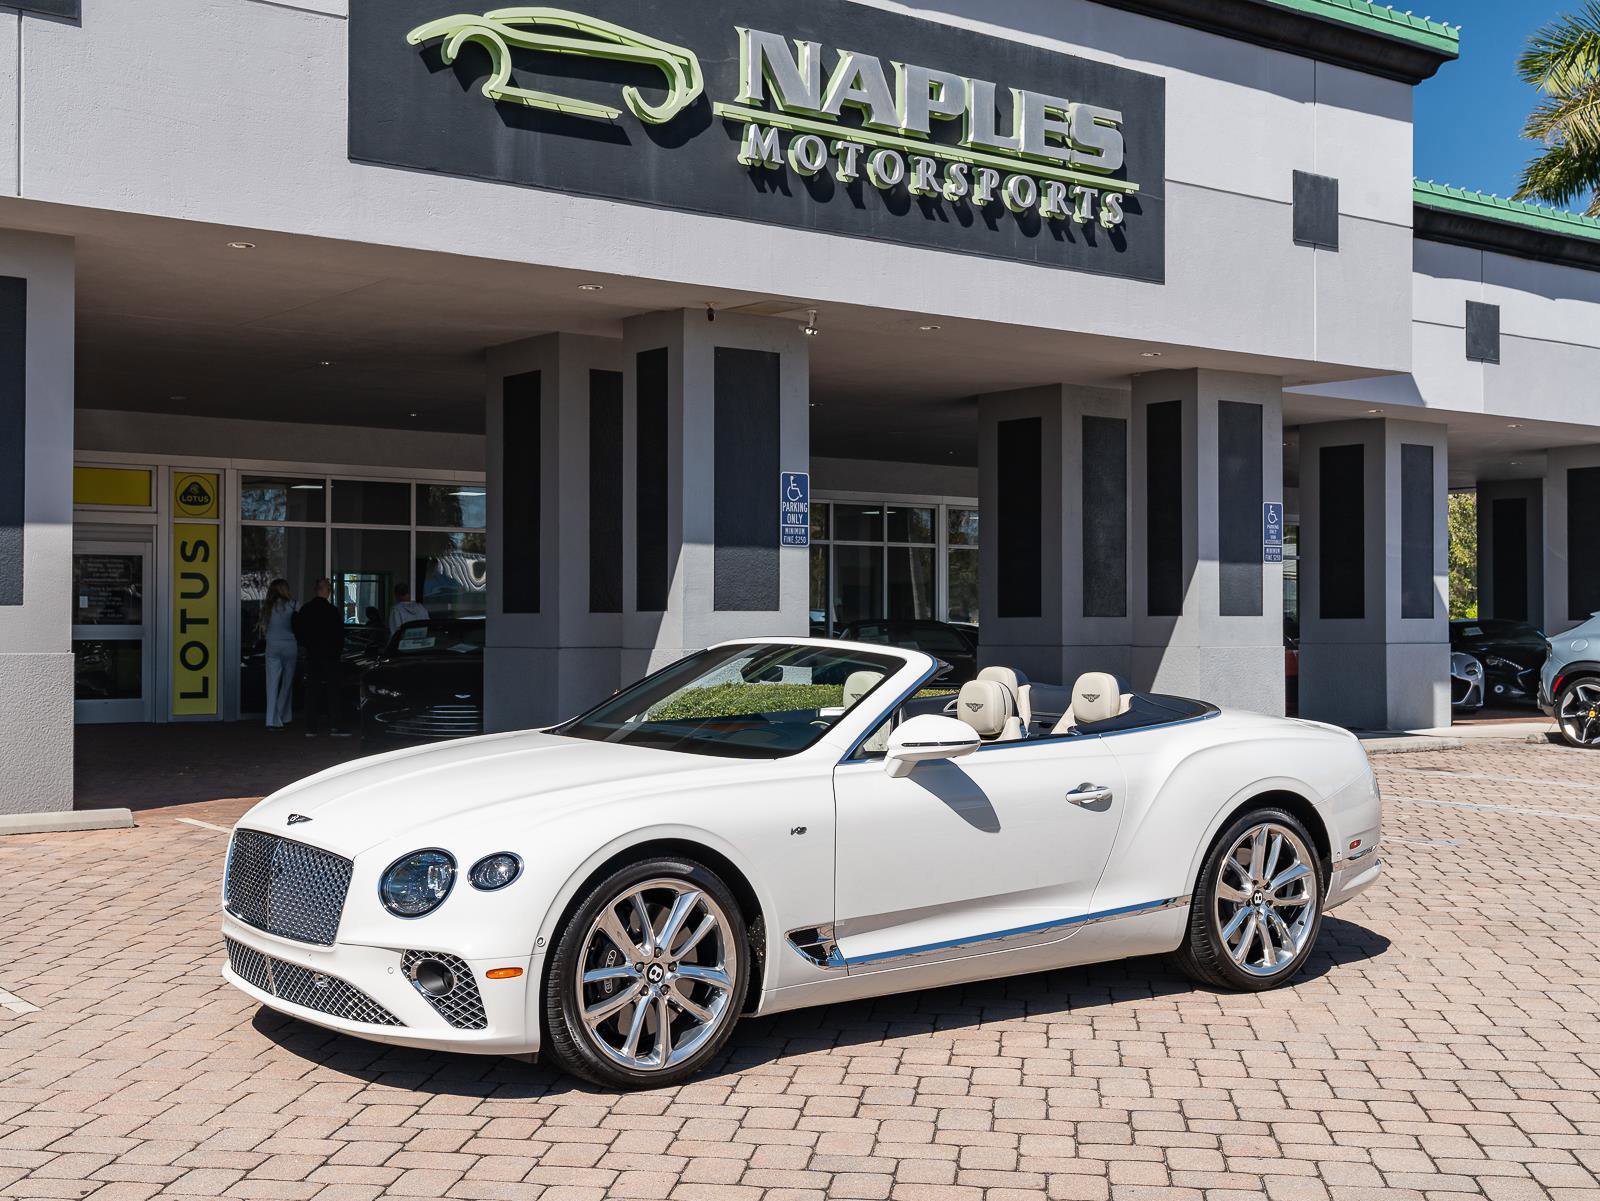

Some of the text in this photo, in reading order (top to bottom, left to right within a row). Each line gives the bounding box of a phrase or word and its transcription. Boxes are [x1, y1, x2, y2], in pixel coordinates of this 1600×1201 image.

[734, 26, 1125, 175] NAPLES
[737, 123, 1124, 228] MOTORSPORTS
[181, 495, 209, 503] LOTUS
[782, 501, 808, 513] PARKING
[787, 513, 803, 524] ONLY
[783, 535, 794, 544] FINE
[180, 539, 210, 700] LOTUS
